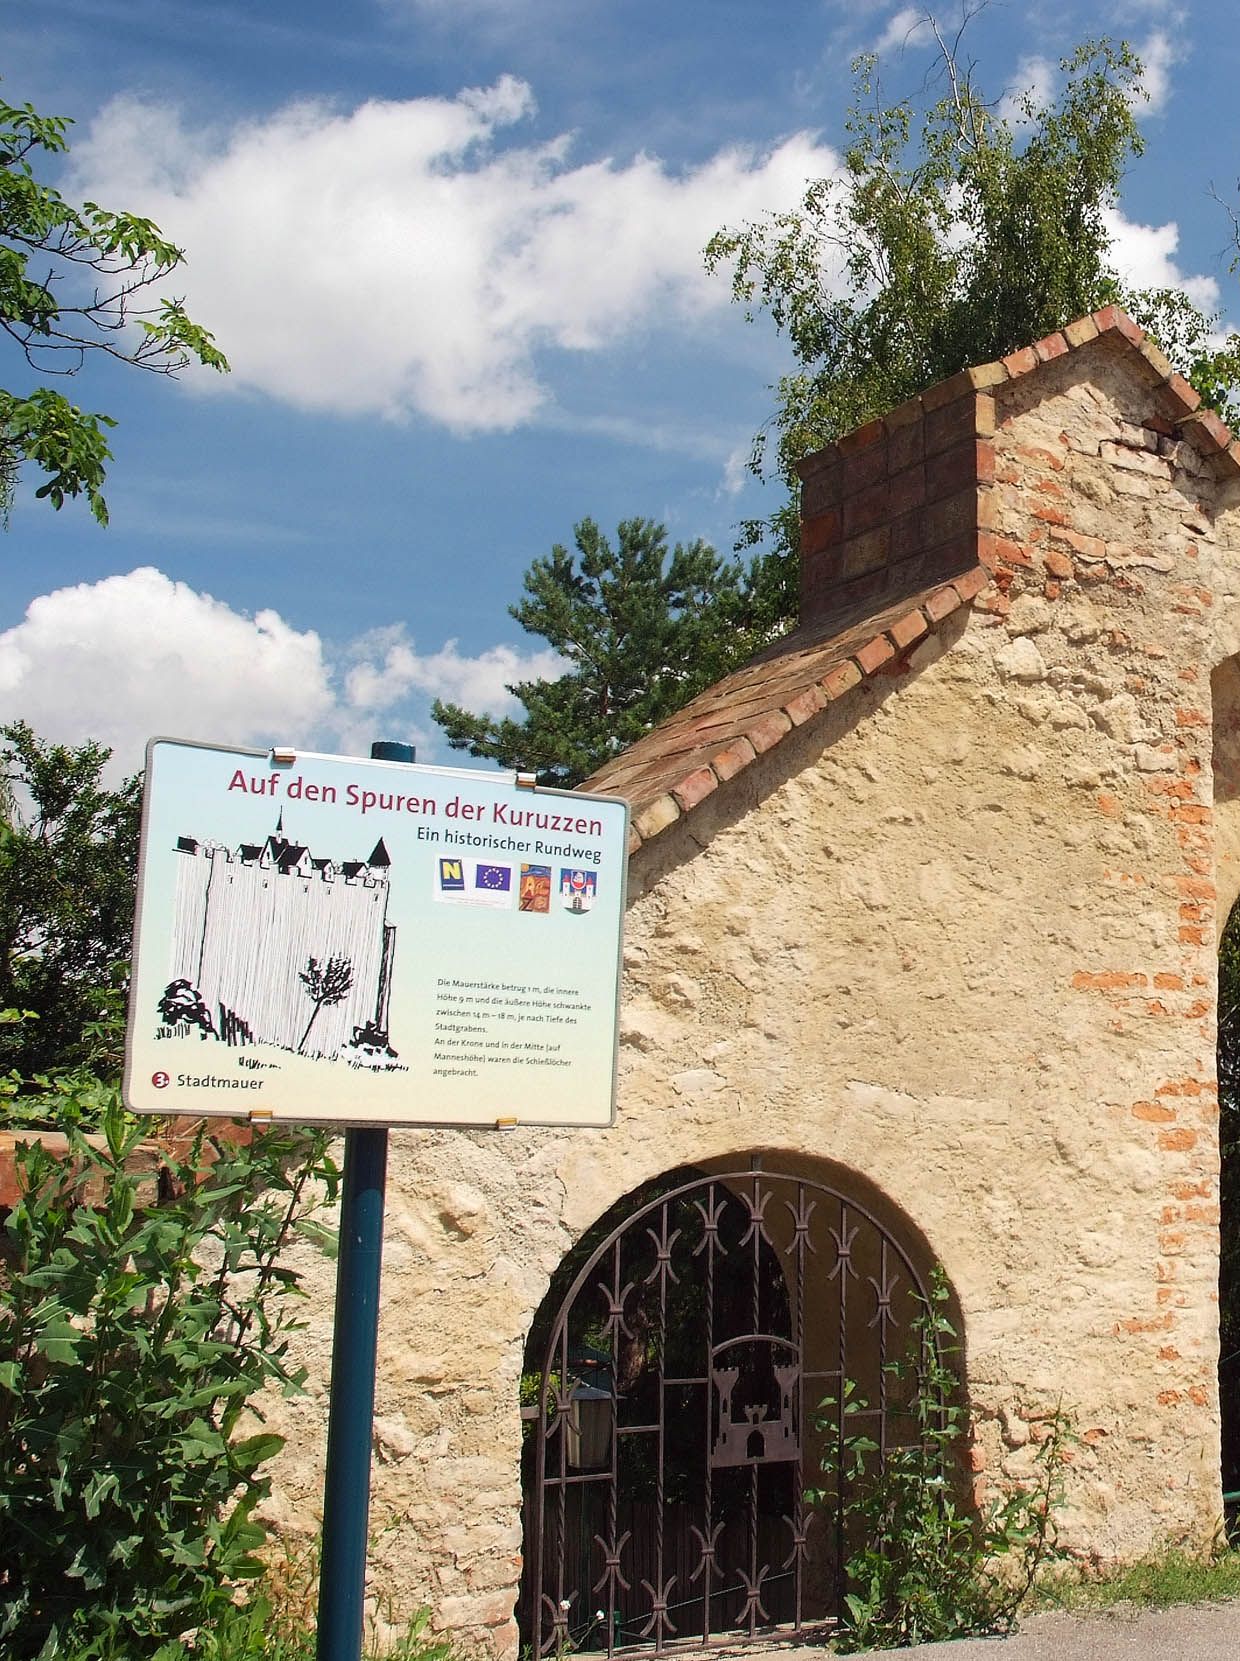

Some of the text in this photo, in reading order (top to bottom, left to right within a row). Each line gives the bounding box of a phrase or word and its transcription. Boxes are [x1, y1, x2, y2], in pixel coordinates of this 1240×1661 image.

[228, 769, 602, 836] Auf den Spuren der Kuruzzen
[417, 827, 602, 864] Ein historischer Rundweg
[437, 978, 450, 986] Die
[452, 979, 500, 990] Mauerstärke
[501, 982, 527, 994] betrug
[543, 986, 555, 994] die
[556, 986, 579, 996] innere
[437, 993, 457, 1001] Höhe
[475, 996, 490, 1004] und
[491, 997, 503, 1005] die
[504, 998, 530, 1007] äußere
[532, 999, 551, 1008] Höhe
[553, 1001, 591, 1011] schwankte
[436, 1009, 471, 1017] zwischen
[517, 1013, 525, 1023] je
[526, 1014, 544, 1022] nach
[546, 1015, 563, 1023] Tiefe
[564, 1016, 577, 1024] des
[435, 1022, 488, 1034] Stadtgrabens.
[434, 1037, 445, 1045] An
[447, 1038, 459, 1046] der
[461, 1039, 483, 1047] Krone
[485, 1040, 500, 1048] und
[525, 1042, 544, 1050] Mitte
[512, 1056, 525, 1064] die
[526, 1057, 572, 1067] Schießlöcher
[433, 1066, 478, 1077] angebracht.
[177, 1074, 264, 1090] Stadtmauer
